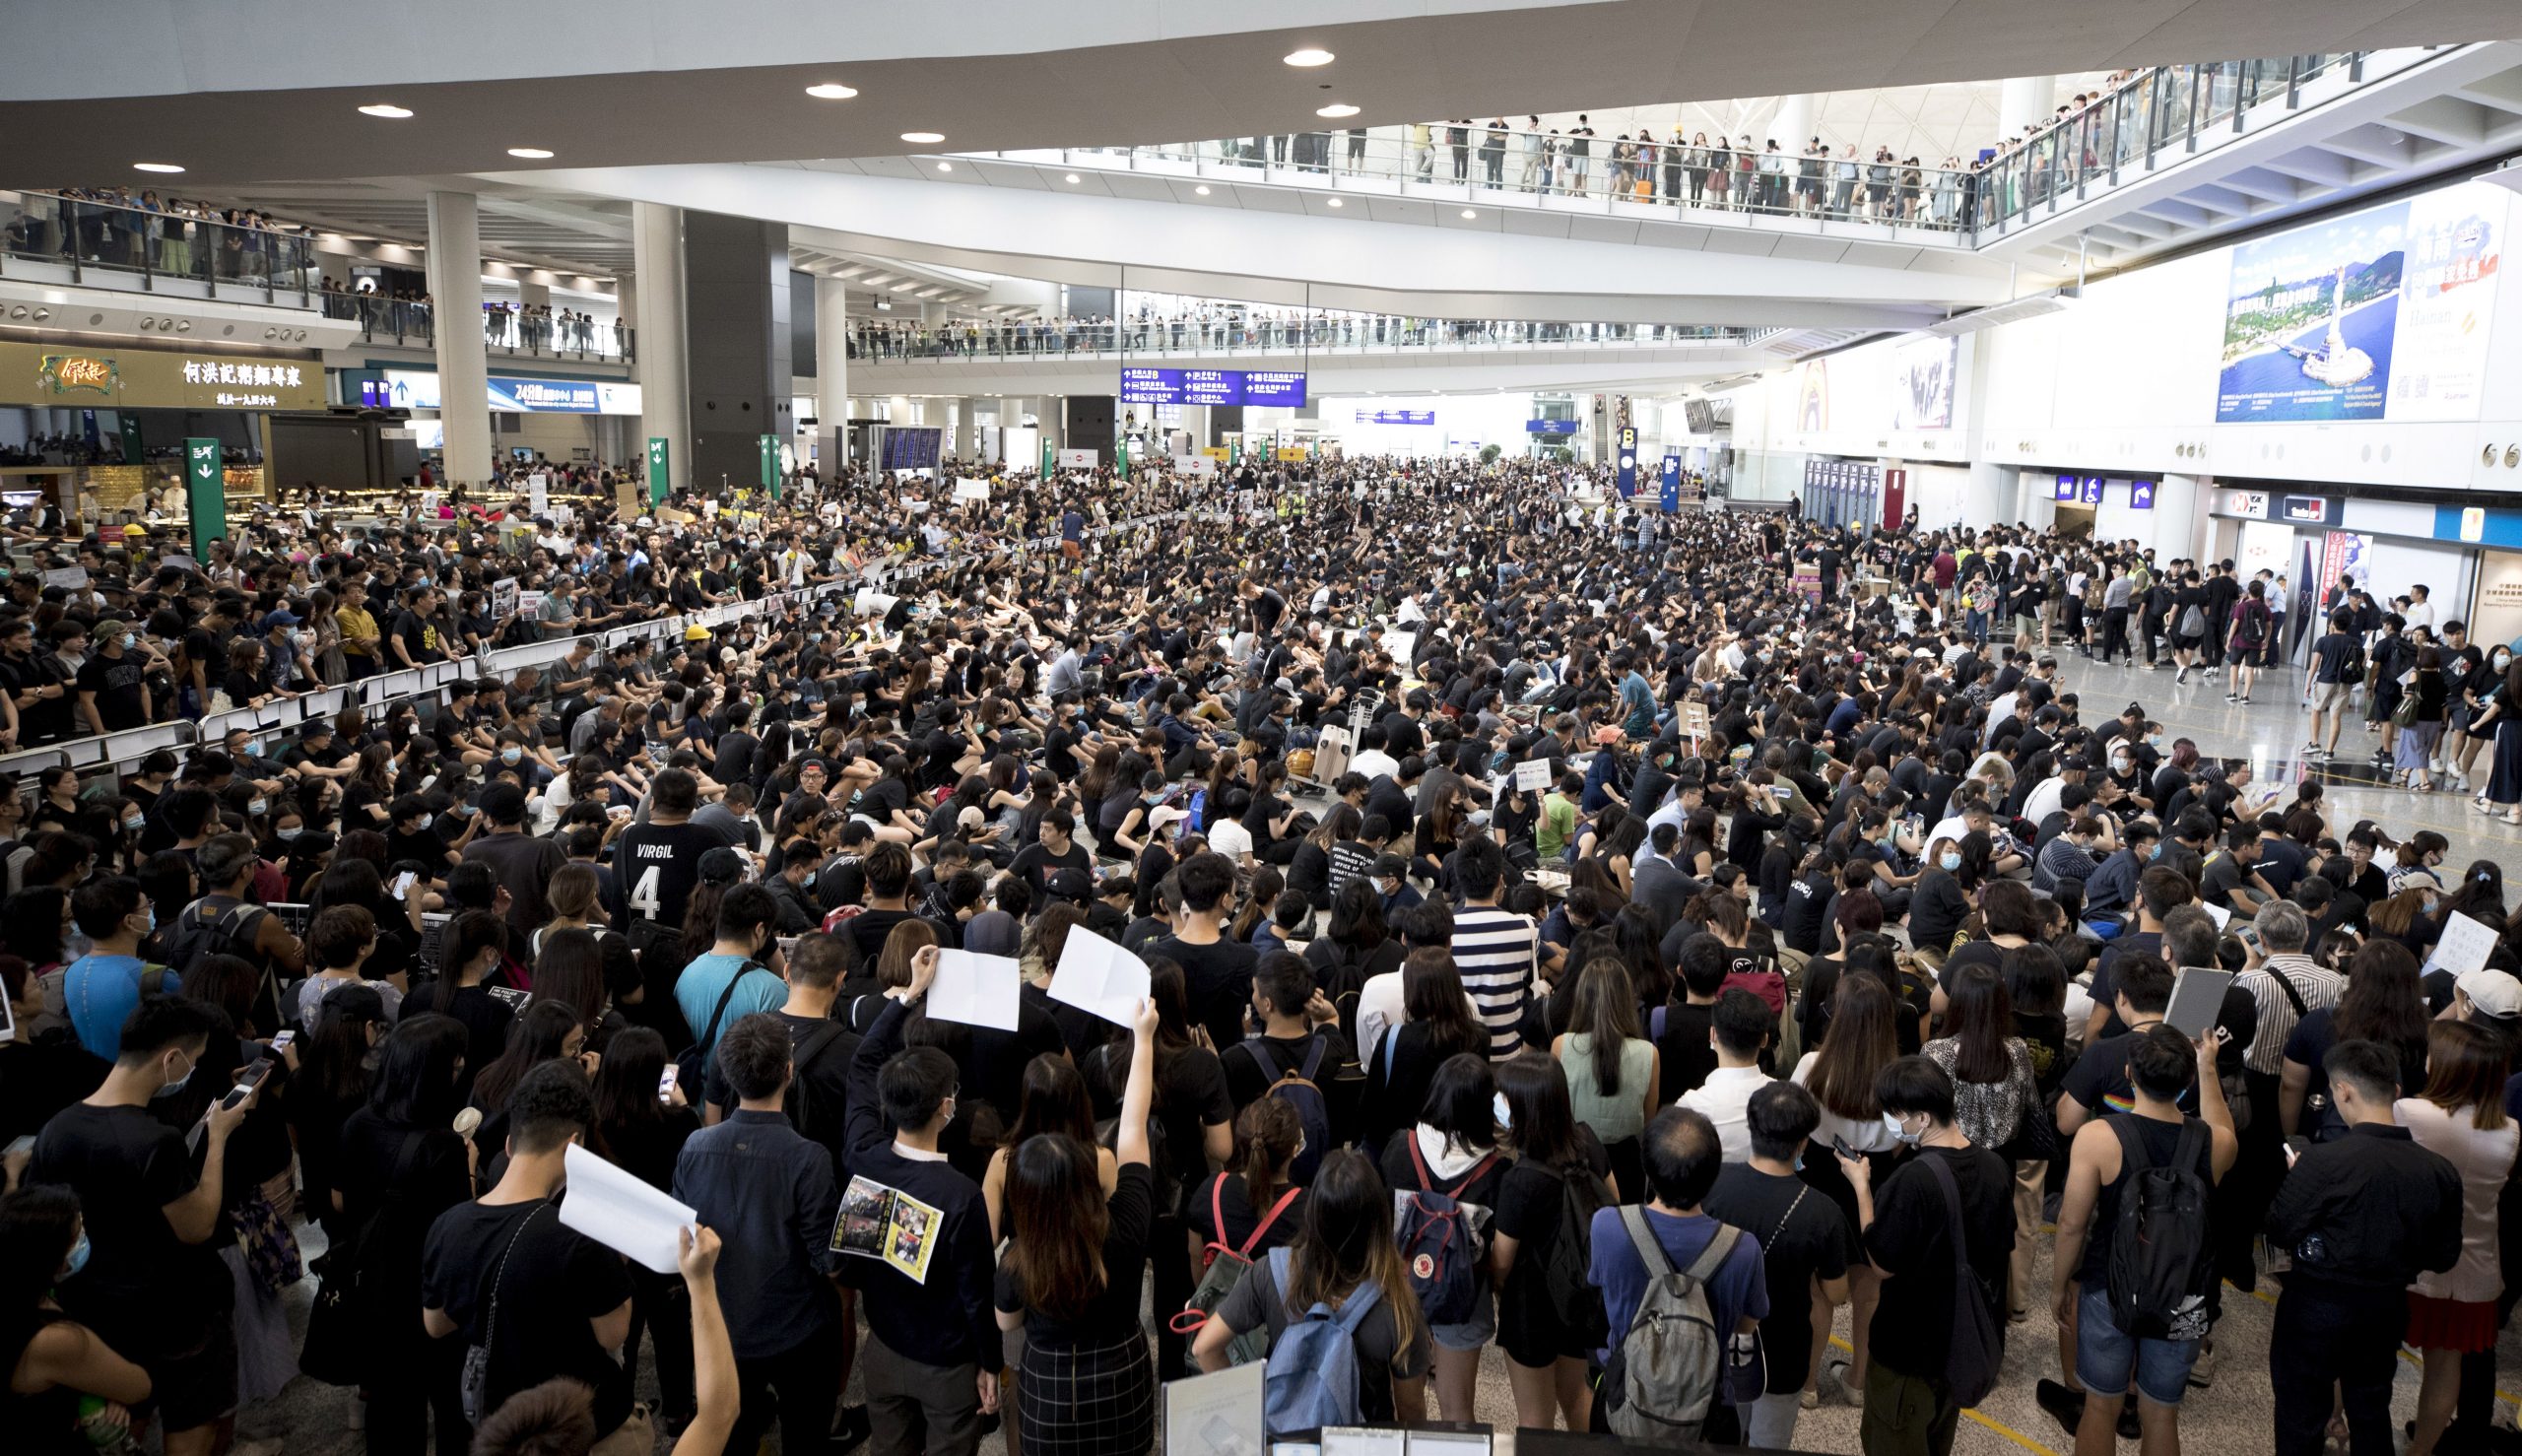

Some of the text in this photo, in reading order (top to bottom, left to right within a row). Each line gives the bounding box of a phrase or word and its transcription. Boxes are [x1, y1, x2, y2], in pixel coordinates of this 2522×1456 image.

[1153, 370, 1159, 379] B
[1624, 430, 1634, 443] B
[636, 843, 674, 859] VIRGIL
[1334, 861, 1351, 870] OFFICE
[630, 865, 661, 920] 4
